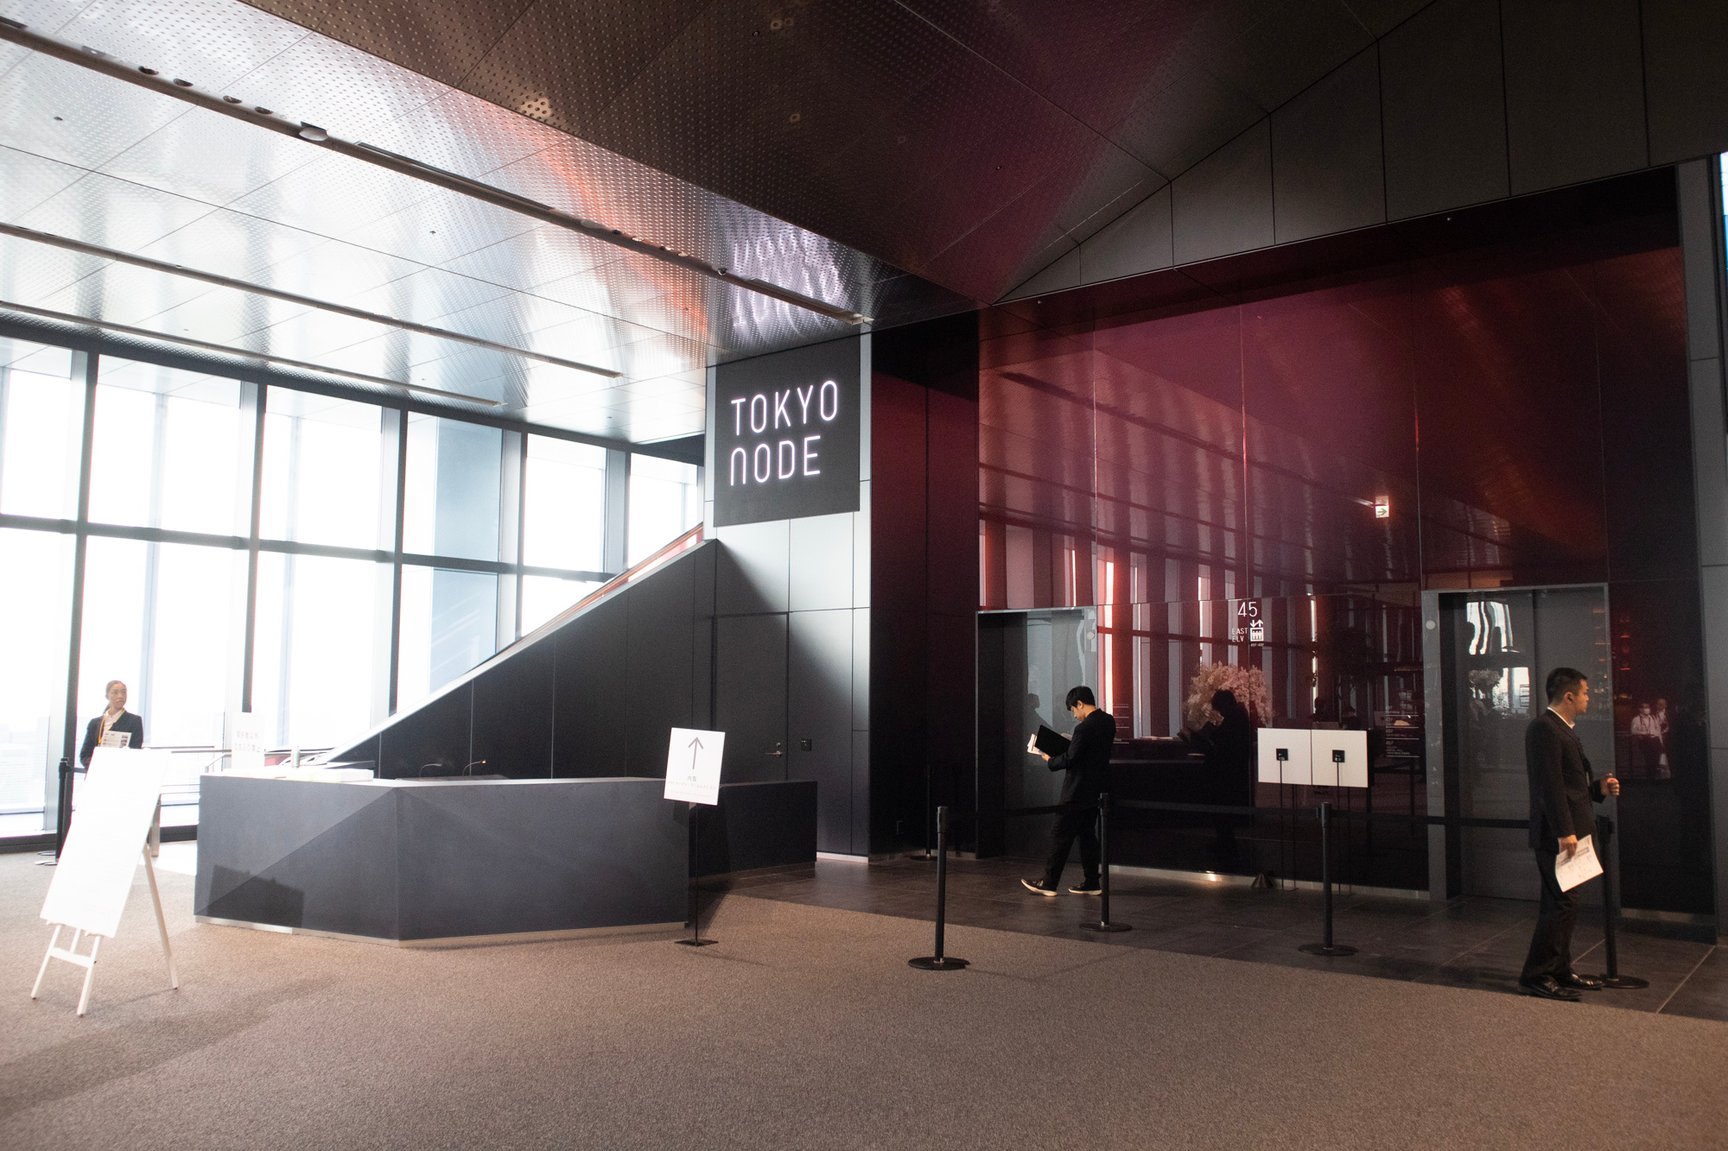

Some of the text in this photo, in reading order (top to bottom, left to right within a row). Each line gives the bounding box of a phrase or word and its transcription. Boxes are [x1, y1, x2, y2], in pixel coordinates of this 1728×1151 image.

[730, 380, 838, 436] TOKYO
[730, 435, 821, 486] NODE
[1238, 601, 1258, 617] 45
[1231, 627, 1248, 635] EAST
